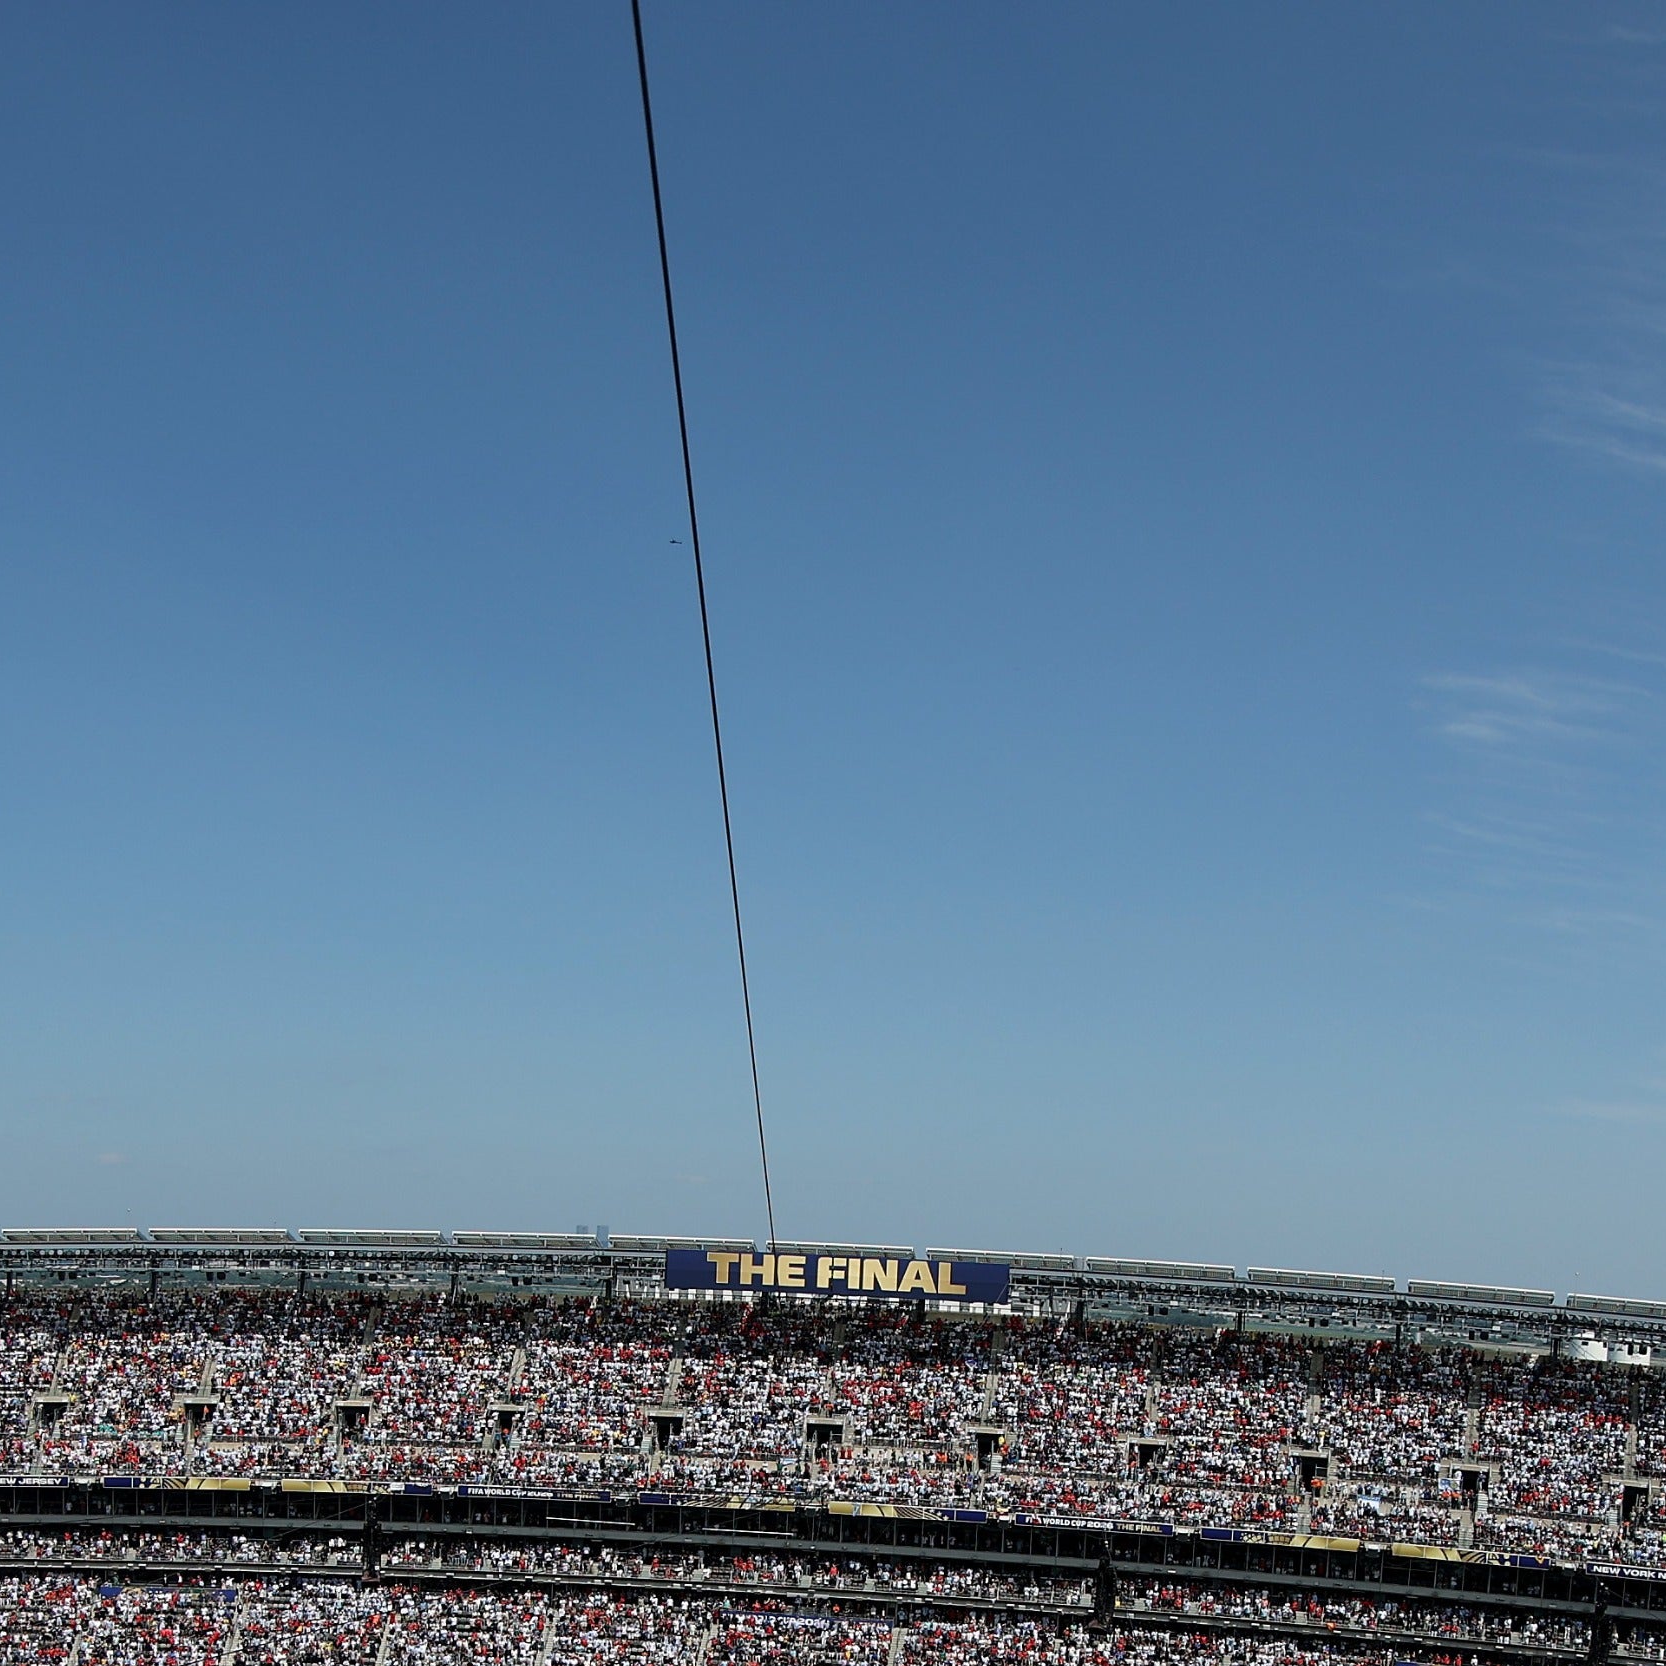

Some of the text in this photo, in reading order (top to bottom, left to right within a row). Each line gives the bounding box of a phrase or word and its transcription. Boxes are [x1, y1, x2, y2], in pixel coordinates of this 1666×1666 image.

[706, 1251, 967, 1295] THE FINAL
[18, 1477, 62, 1485] JERSEY
[1042, 1517, 1070, 1527] WORLD
[1071, 1519, 1086, 1527] CUP
[1087, 1521, 1113, 1530] 2026
[1135, 1524, 1163, 1533] FINAL
[1592, 1565, 1619, 1575] NEW
[1622, 1568, 1656, 1578] YORK
